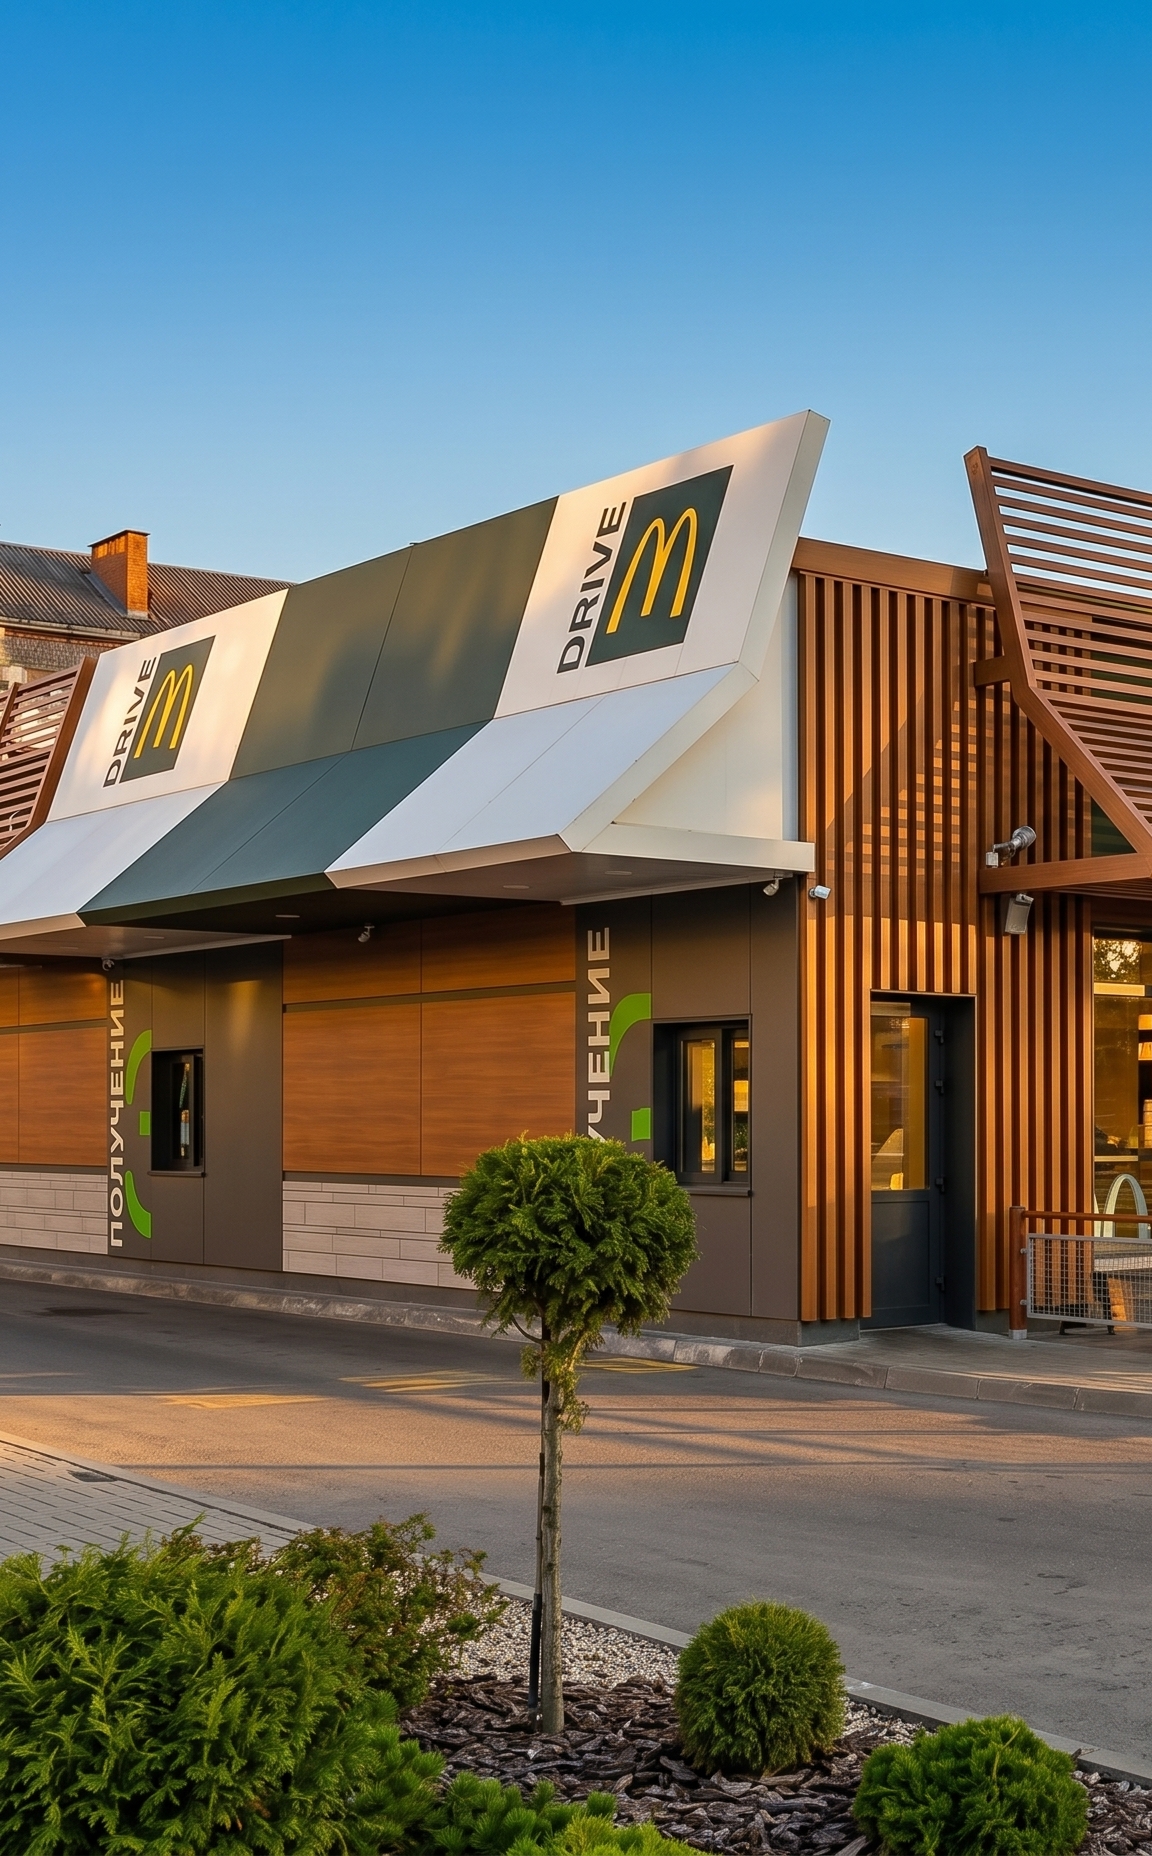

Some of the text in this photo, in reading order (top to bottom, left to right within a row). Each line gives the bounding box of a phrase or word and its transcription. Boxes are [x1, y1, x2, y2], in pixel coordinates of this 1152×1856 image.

[557, 501, 627, 674] DRIVE
[103, 656, 157, 788] DRIVE
[110, 980, 124, 1247] ПОЛУЧЕНИЕ
